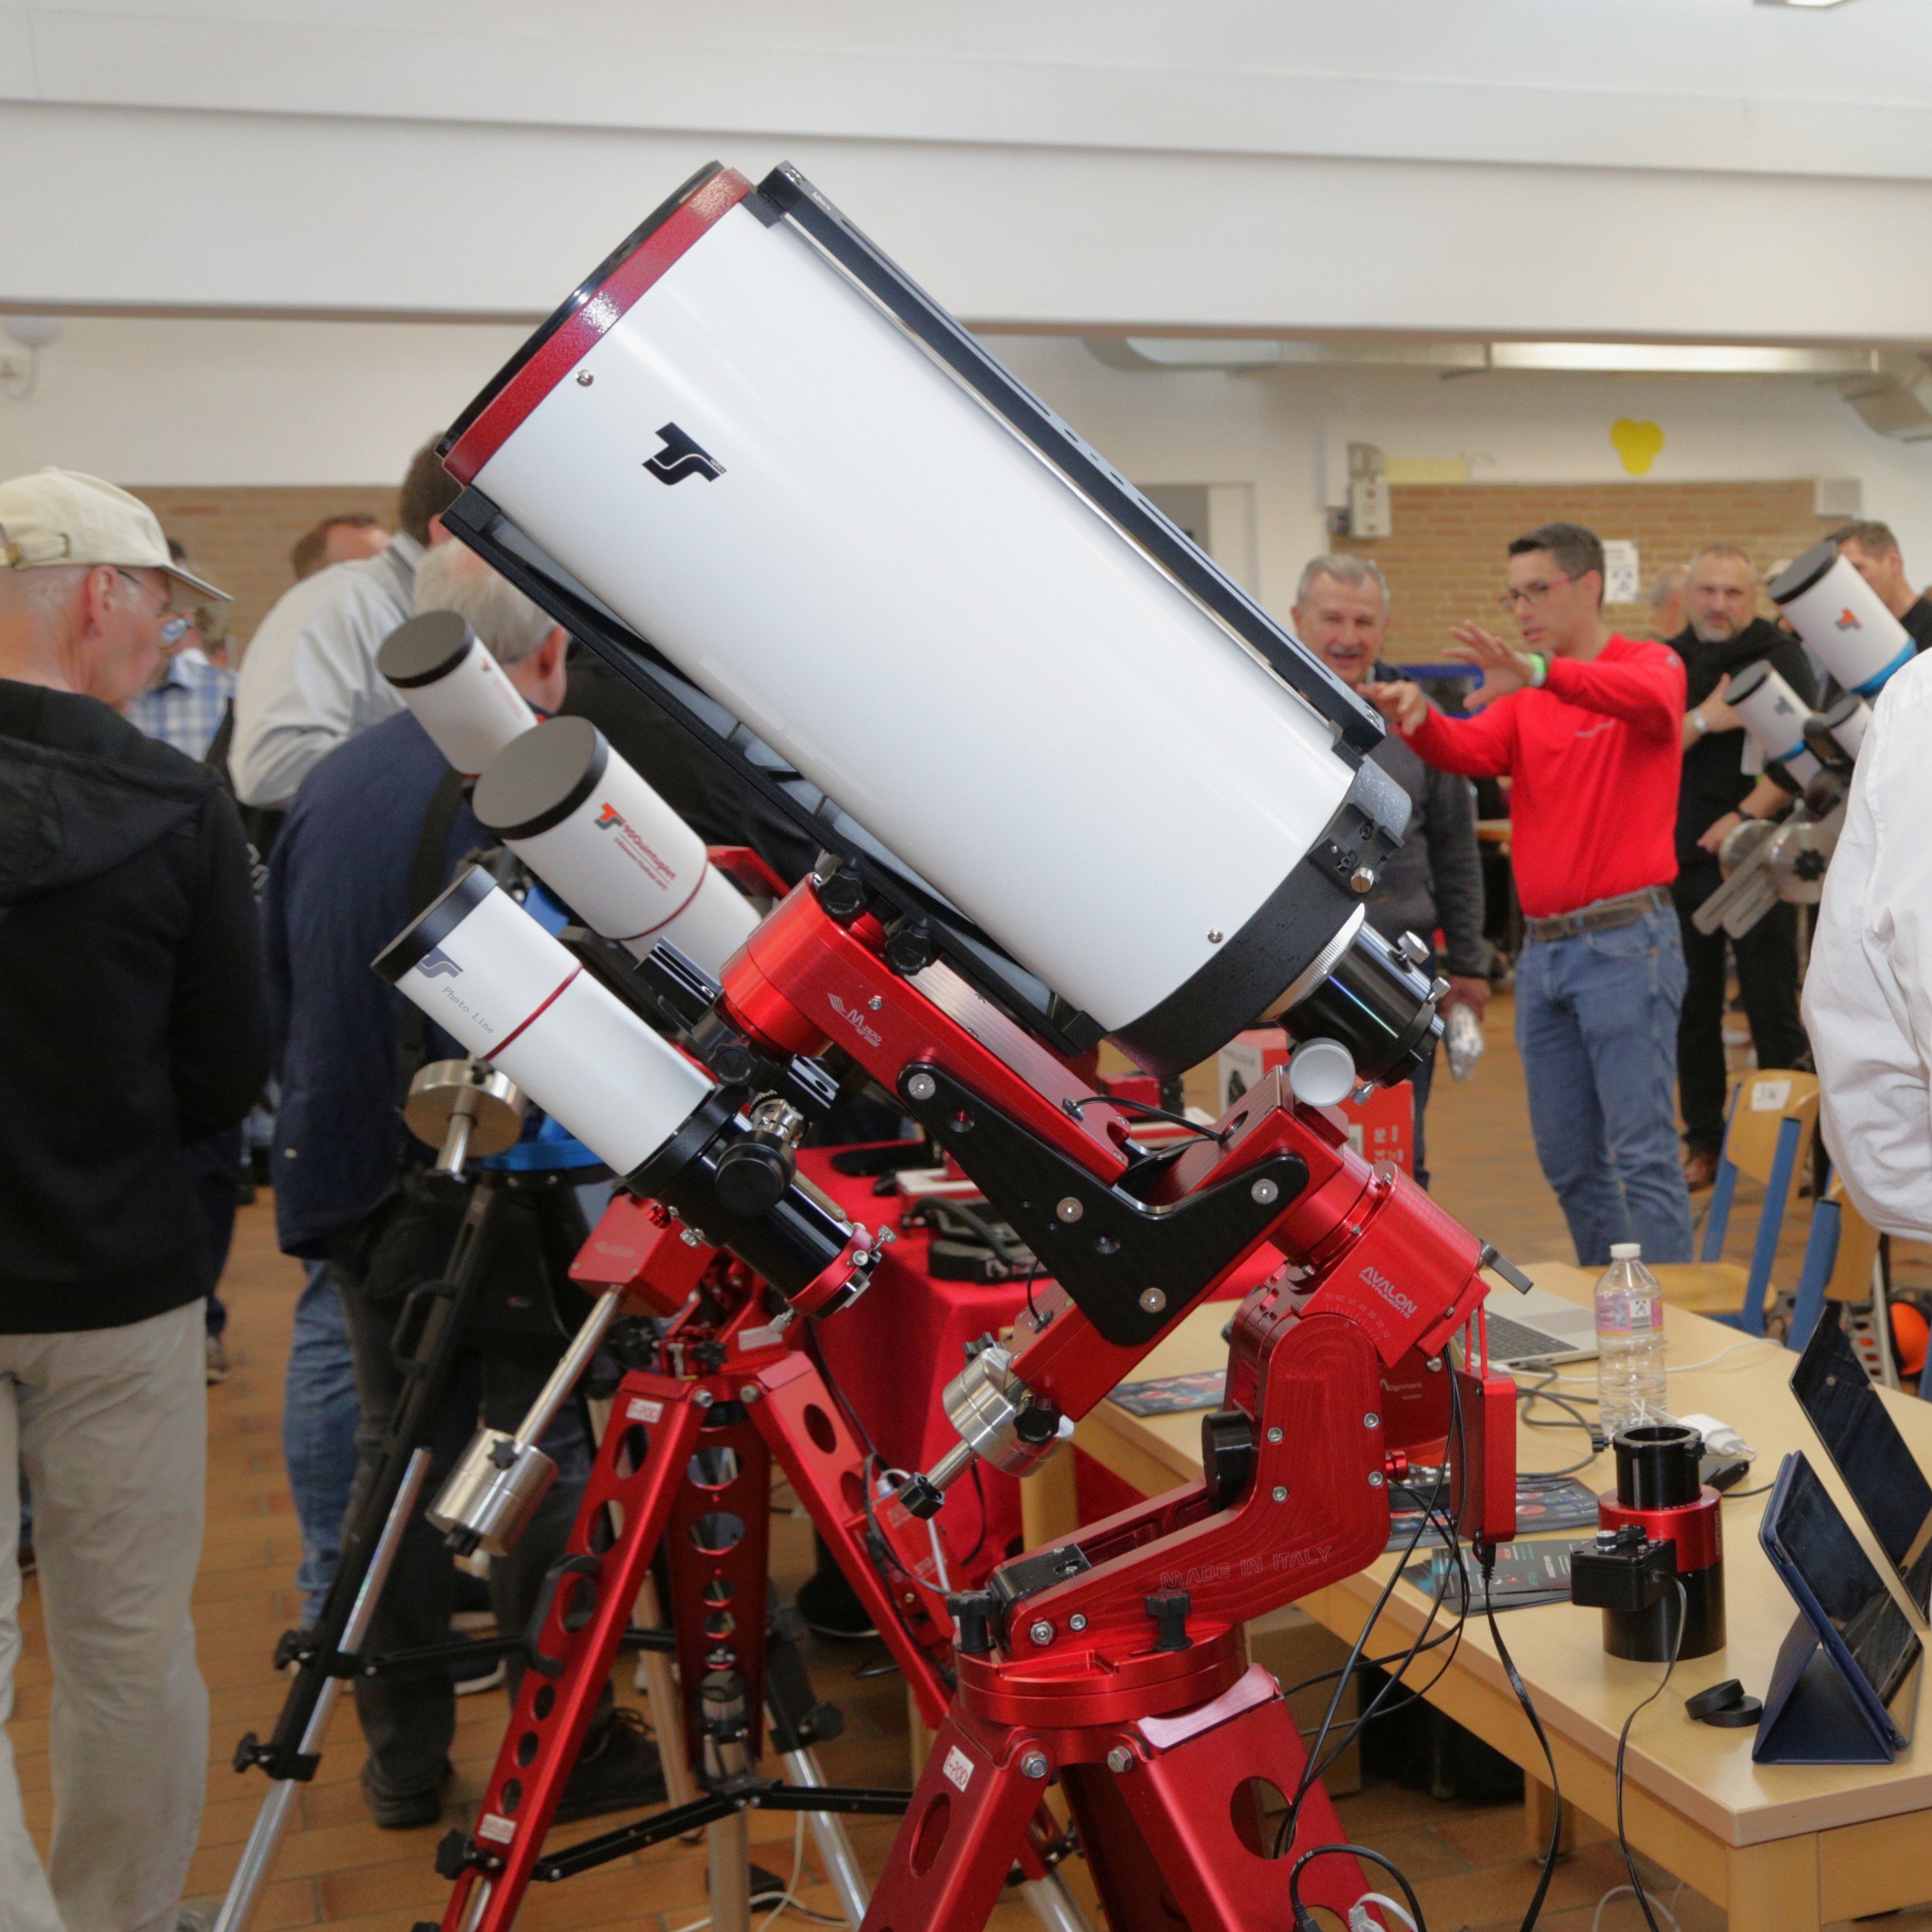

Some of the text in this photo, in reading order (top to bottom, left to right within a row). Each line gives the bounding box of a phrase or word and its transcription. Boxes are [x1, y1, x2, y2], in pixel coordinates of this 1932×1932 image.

[442, 986, 494, 1034] Photo Line
[1359, 1272, 1411, 1319] INSTRUMENTS
[1361, 1266, 1418, 1314] AVALON
[1160, 1545, 1332, 1590] MADE IN ITALY
